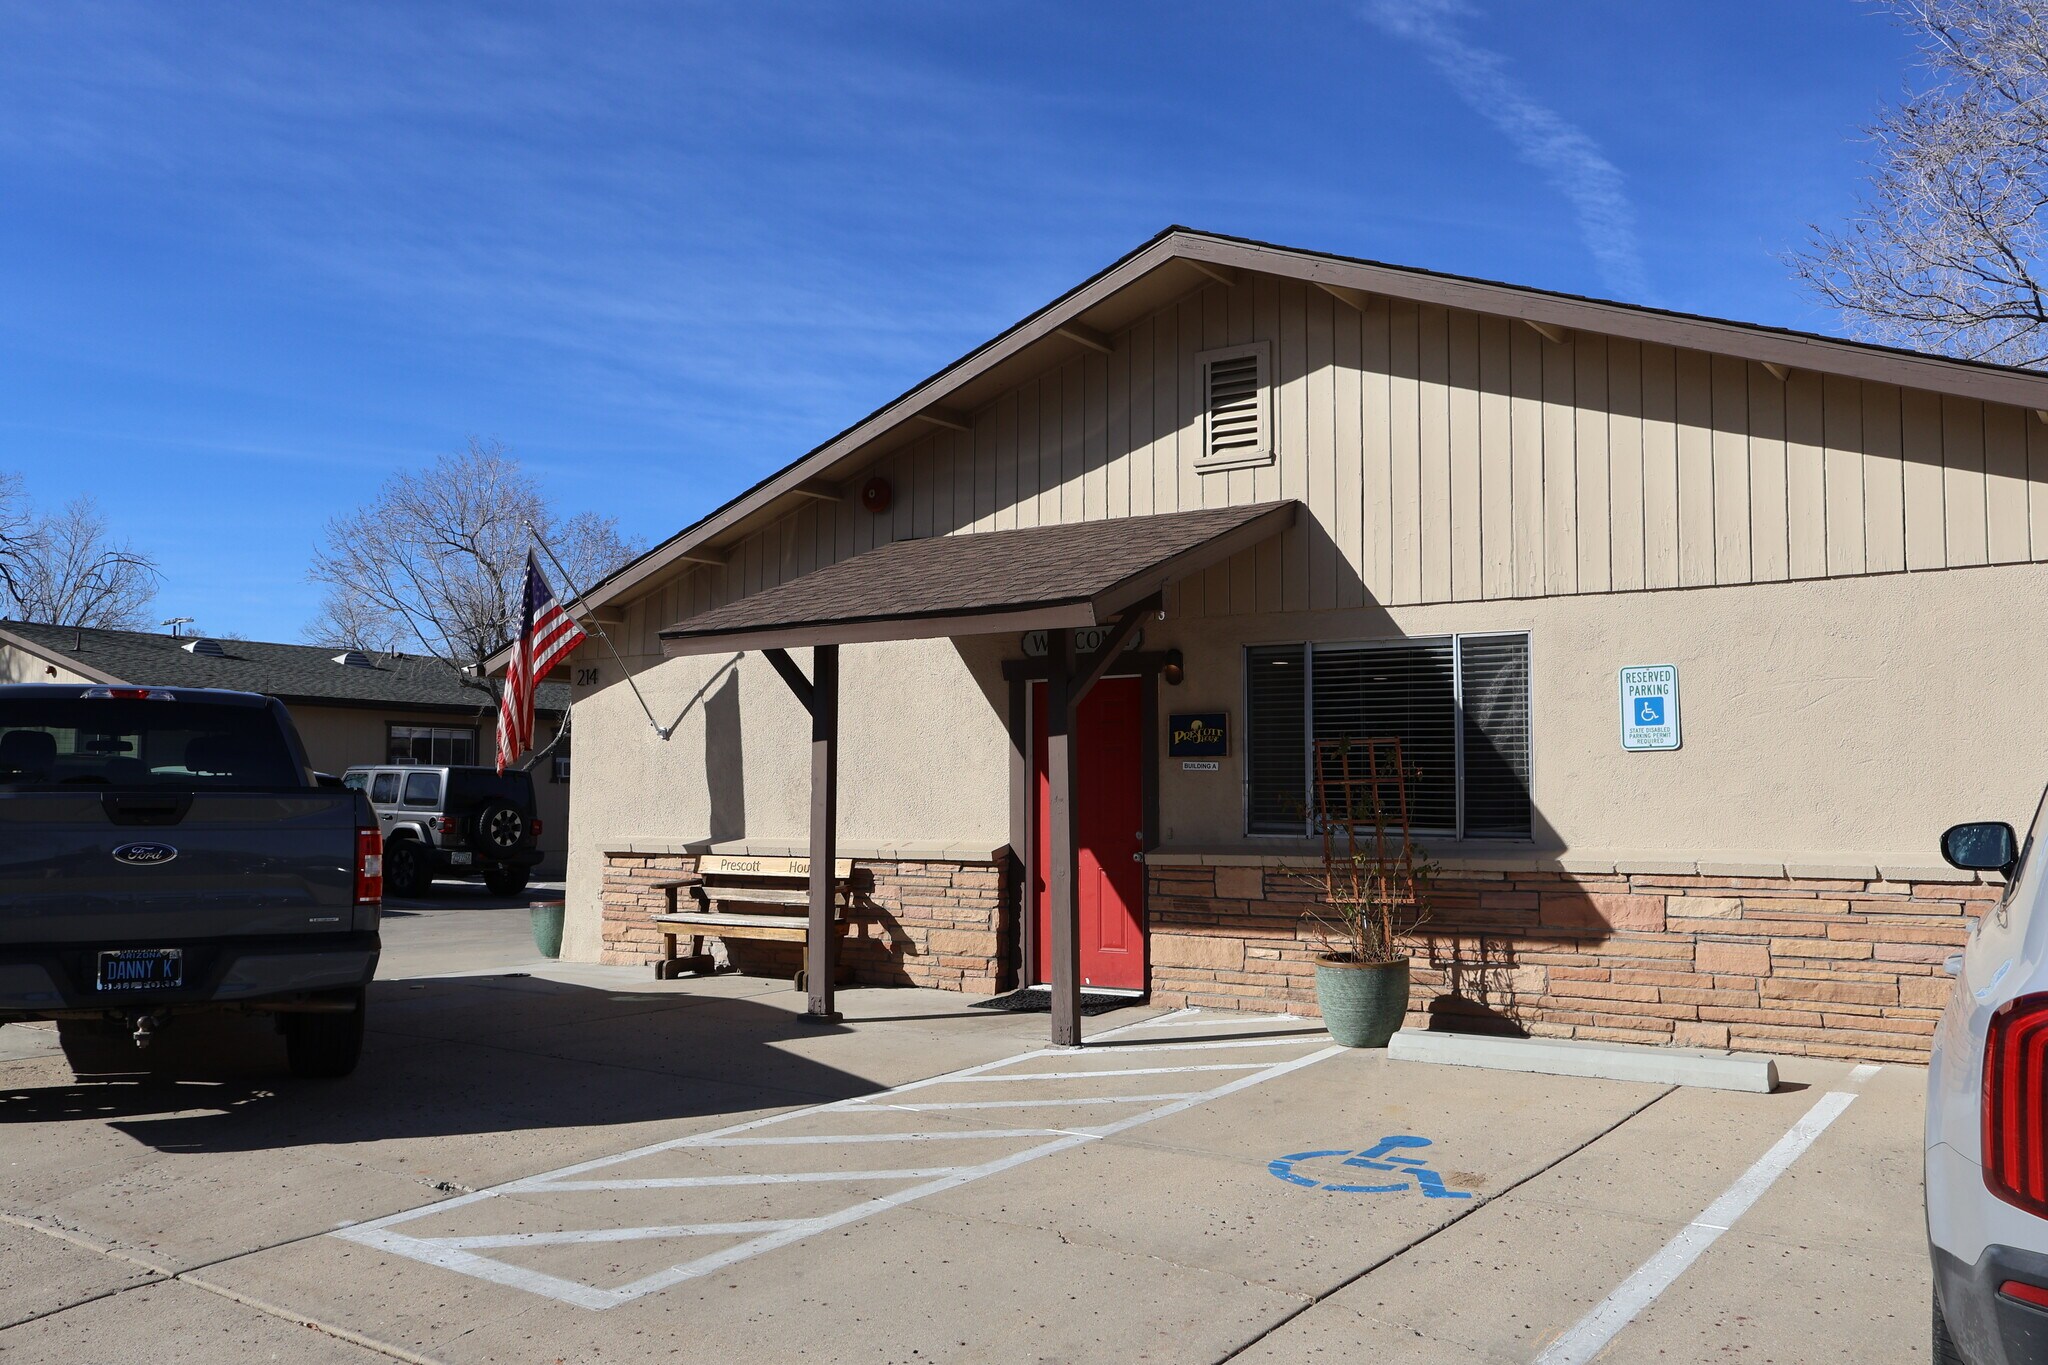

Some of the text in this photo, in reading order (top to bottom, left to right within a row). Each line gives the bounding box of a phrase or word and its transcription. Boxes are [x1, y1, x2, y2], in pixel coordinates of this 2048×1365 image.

[577, 668, 598, 686] 214
[1626, 671, 1670, 683] RESERVED
[1630, 684, 1669, 696] PARKING
[128, 846, 163, 860] Ford
[720, 858, 810, 873] Prescott Hou
[107, 960, 172, 980] DANNY K
